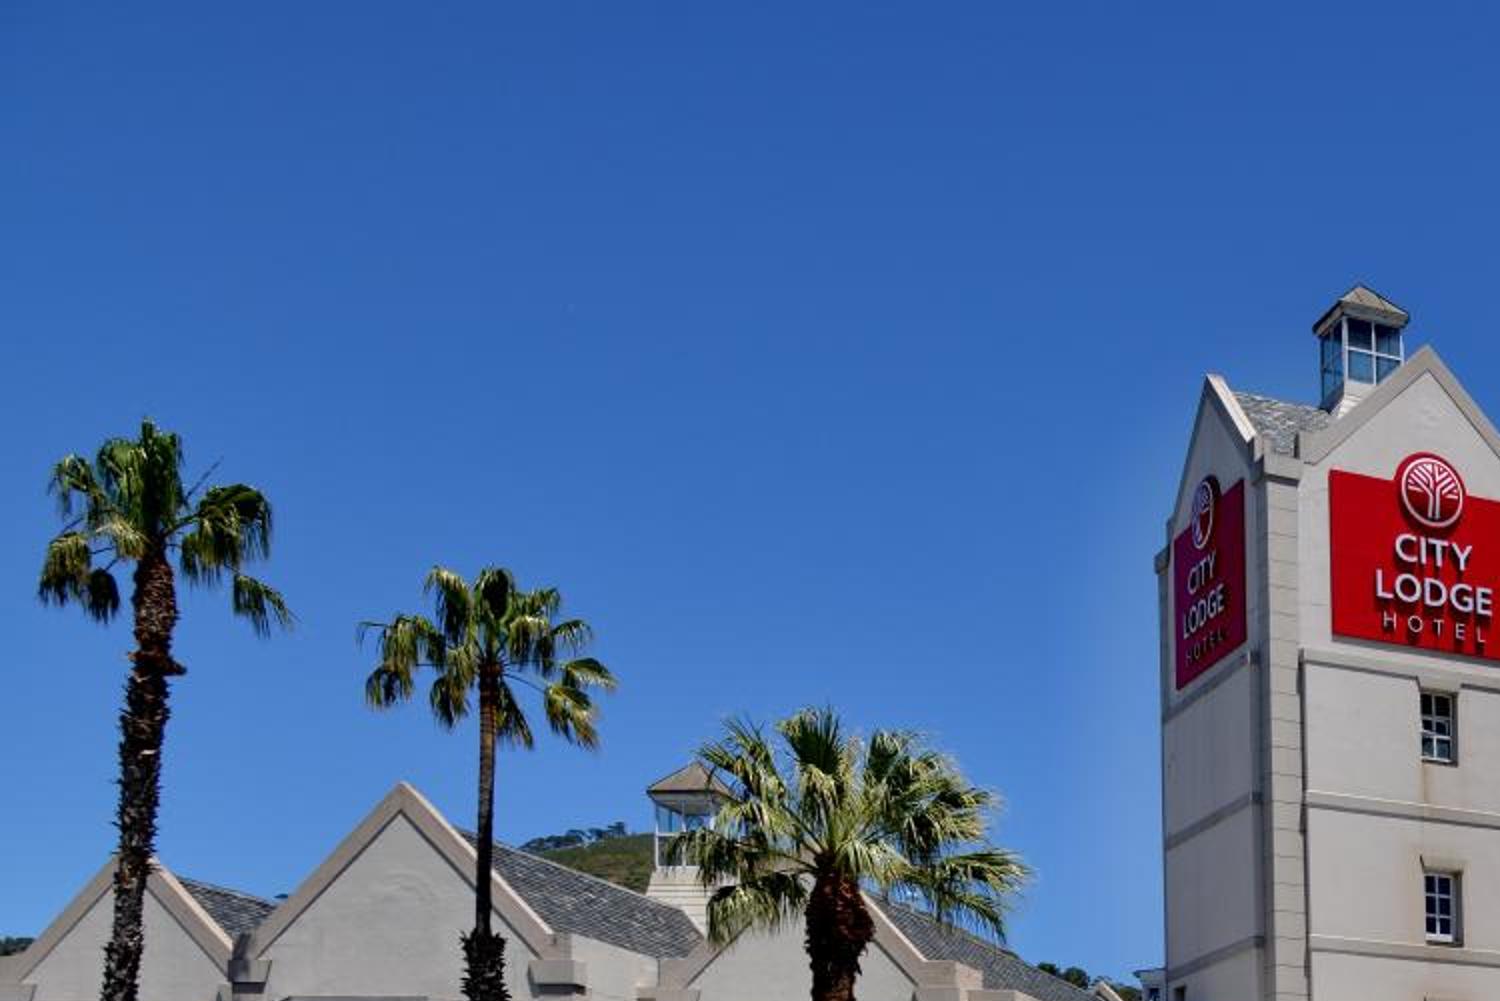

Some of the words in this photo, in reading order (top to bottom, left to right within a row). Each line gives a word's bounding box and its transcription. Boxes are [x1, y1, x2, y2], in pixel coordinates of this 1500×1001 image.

[1187, 549, 1217, 595] CITY
[1395, 533, 1473, 571] CITY
[1183, 583, 1225, 639] LODGE
[1375, 568, 1493, 616] LODGE
[1383, 610, 1486, 643] HOTEL
[1185, 629, 1224, 667] HOTEL
